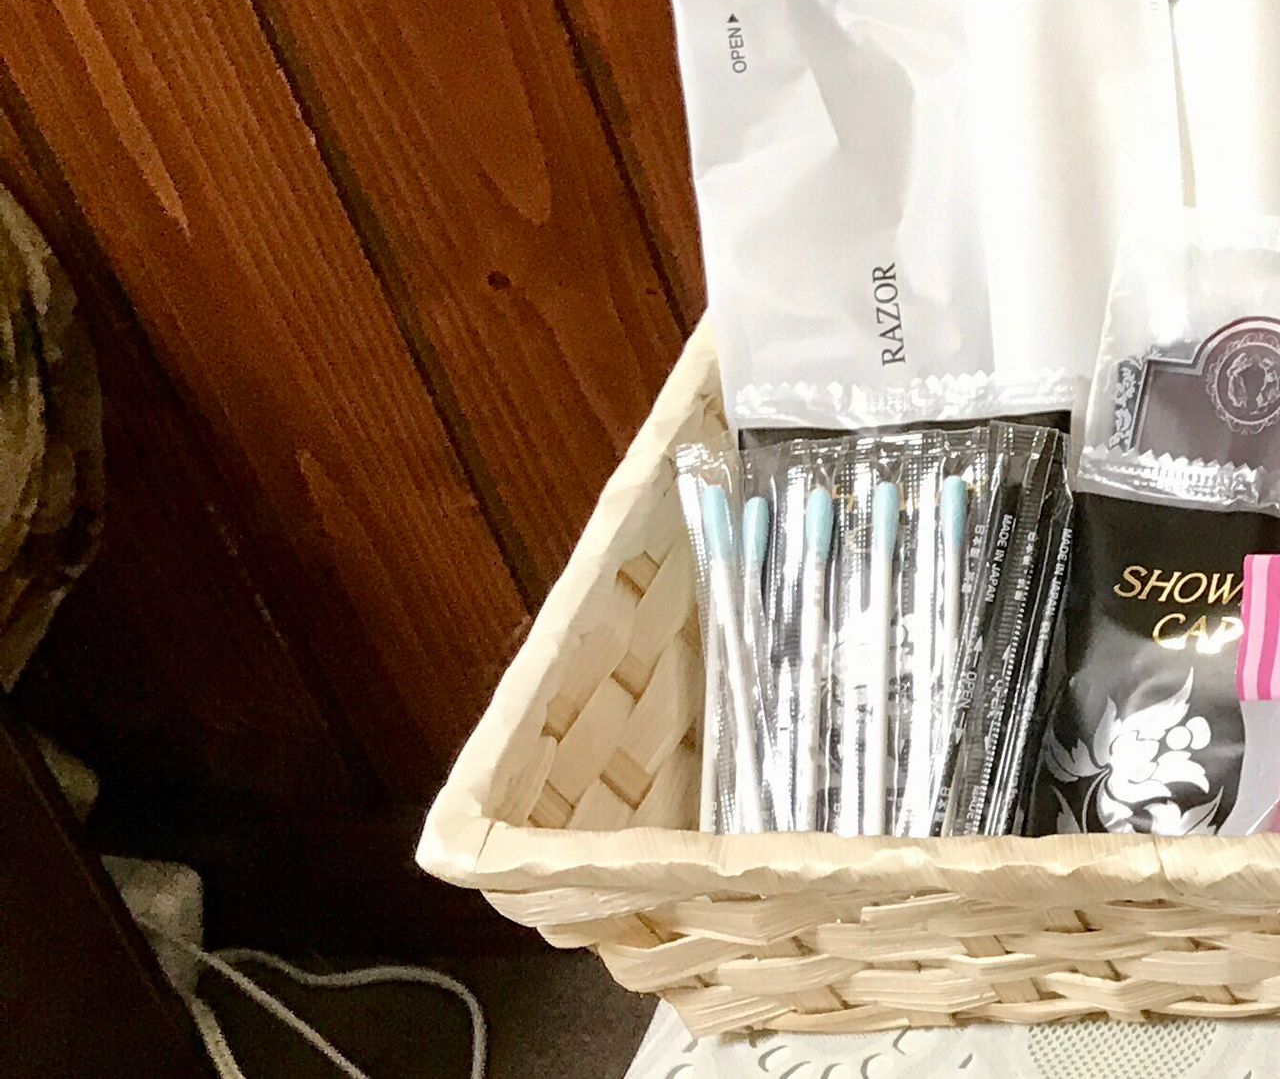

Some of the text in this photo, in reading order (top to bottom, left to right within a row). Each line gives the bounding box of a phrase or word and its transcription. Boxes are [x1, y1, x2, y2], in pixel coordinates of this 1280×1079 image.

[727, 27, 748, 73] OPEN
[872, 262, 907, 366] RAZOR
[984, 513, 1014, 603] MADE IN JAPAN
[1056, 527, 1073, 561] MADE
[1113, 565, 1244, 607] SHOW
[958, 671, 978, 709] OPEN
